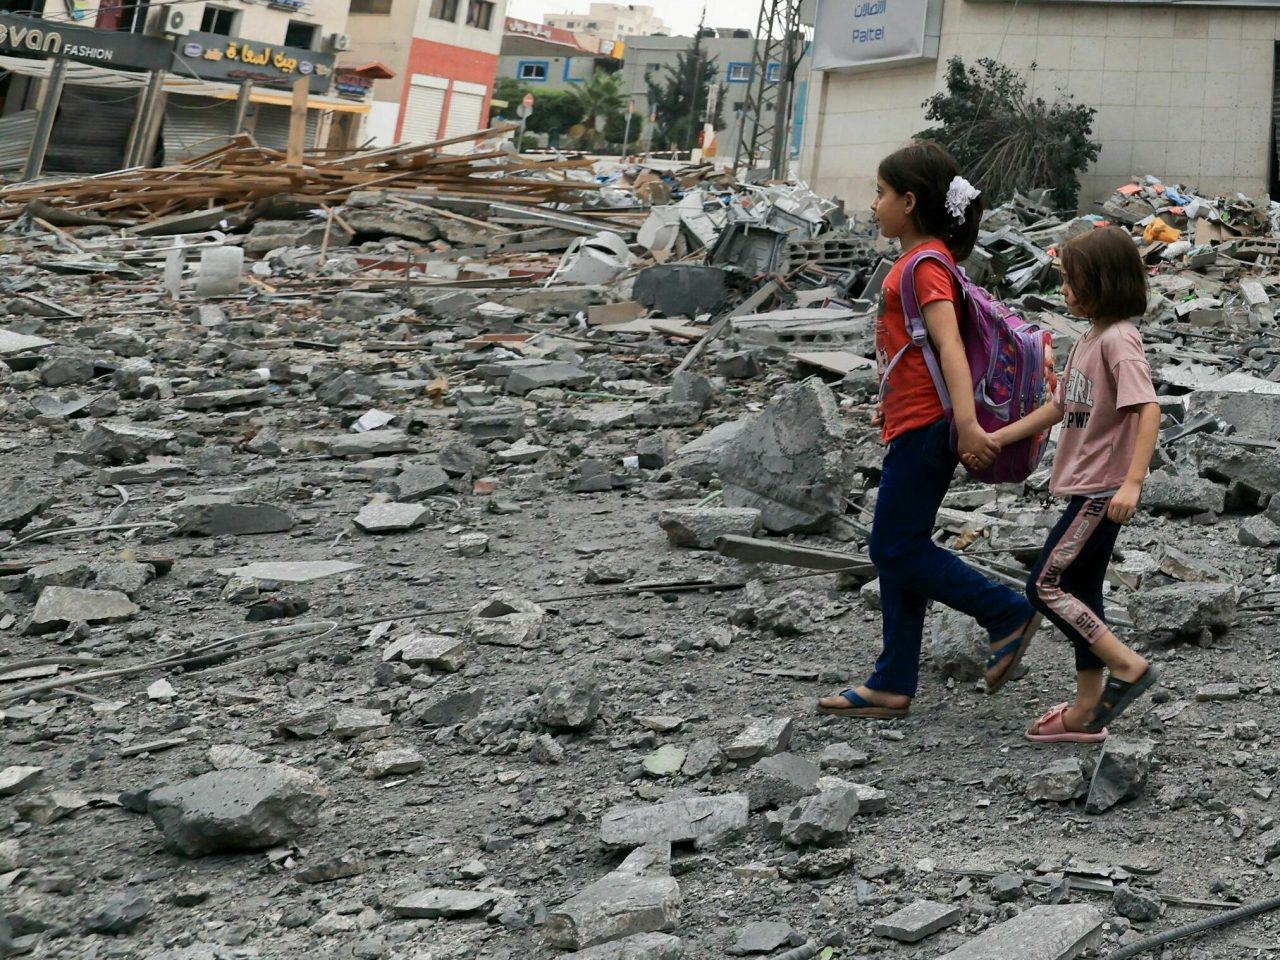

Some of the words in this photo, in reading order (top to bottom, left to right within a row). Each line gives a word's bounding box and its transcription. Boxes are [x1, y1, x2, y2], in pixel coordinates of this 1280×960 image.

[852, 25, 885, 43] Paltel
[63, 44, 113, 60] FASHION
[1076, 612, 1099, 638] GIRL
